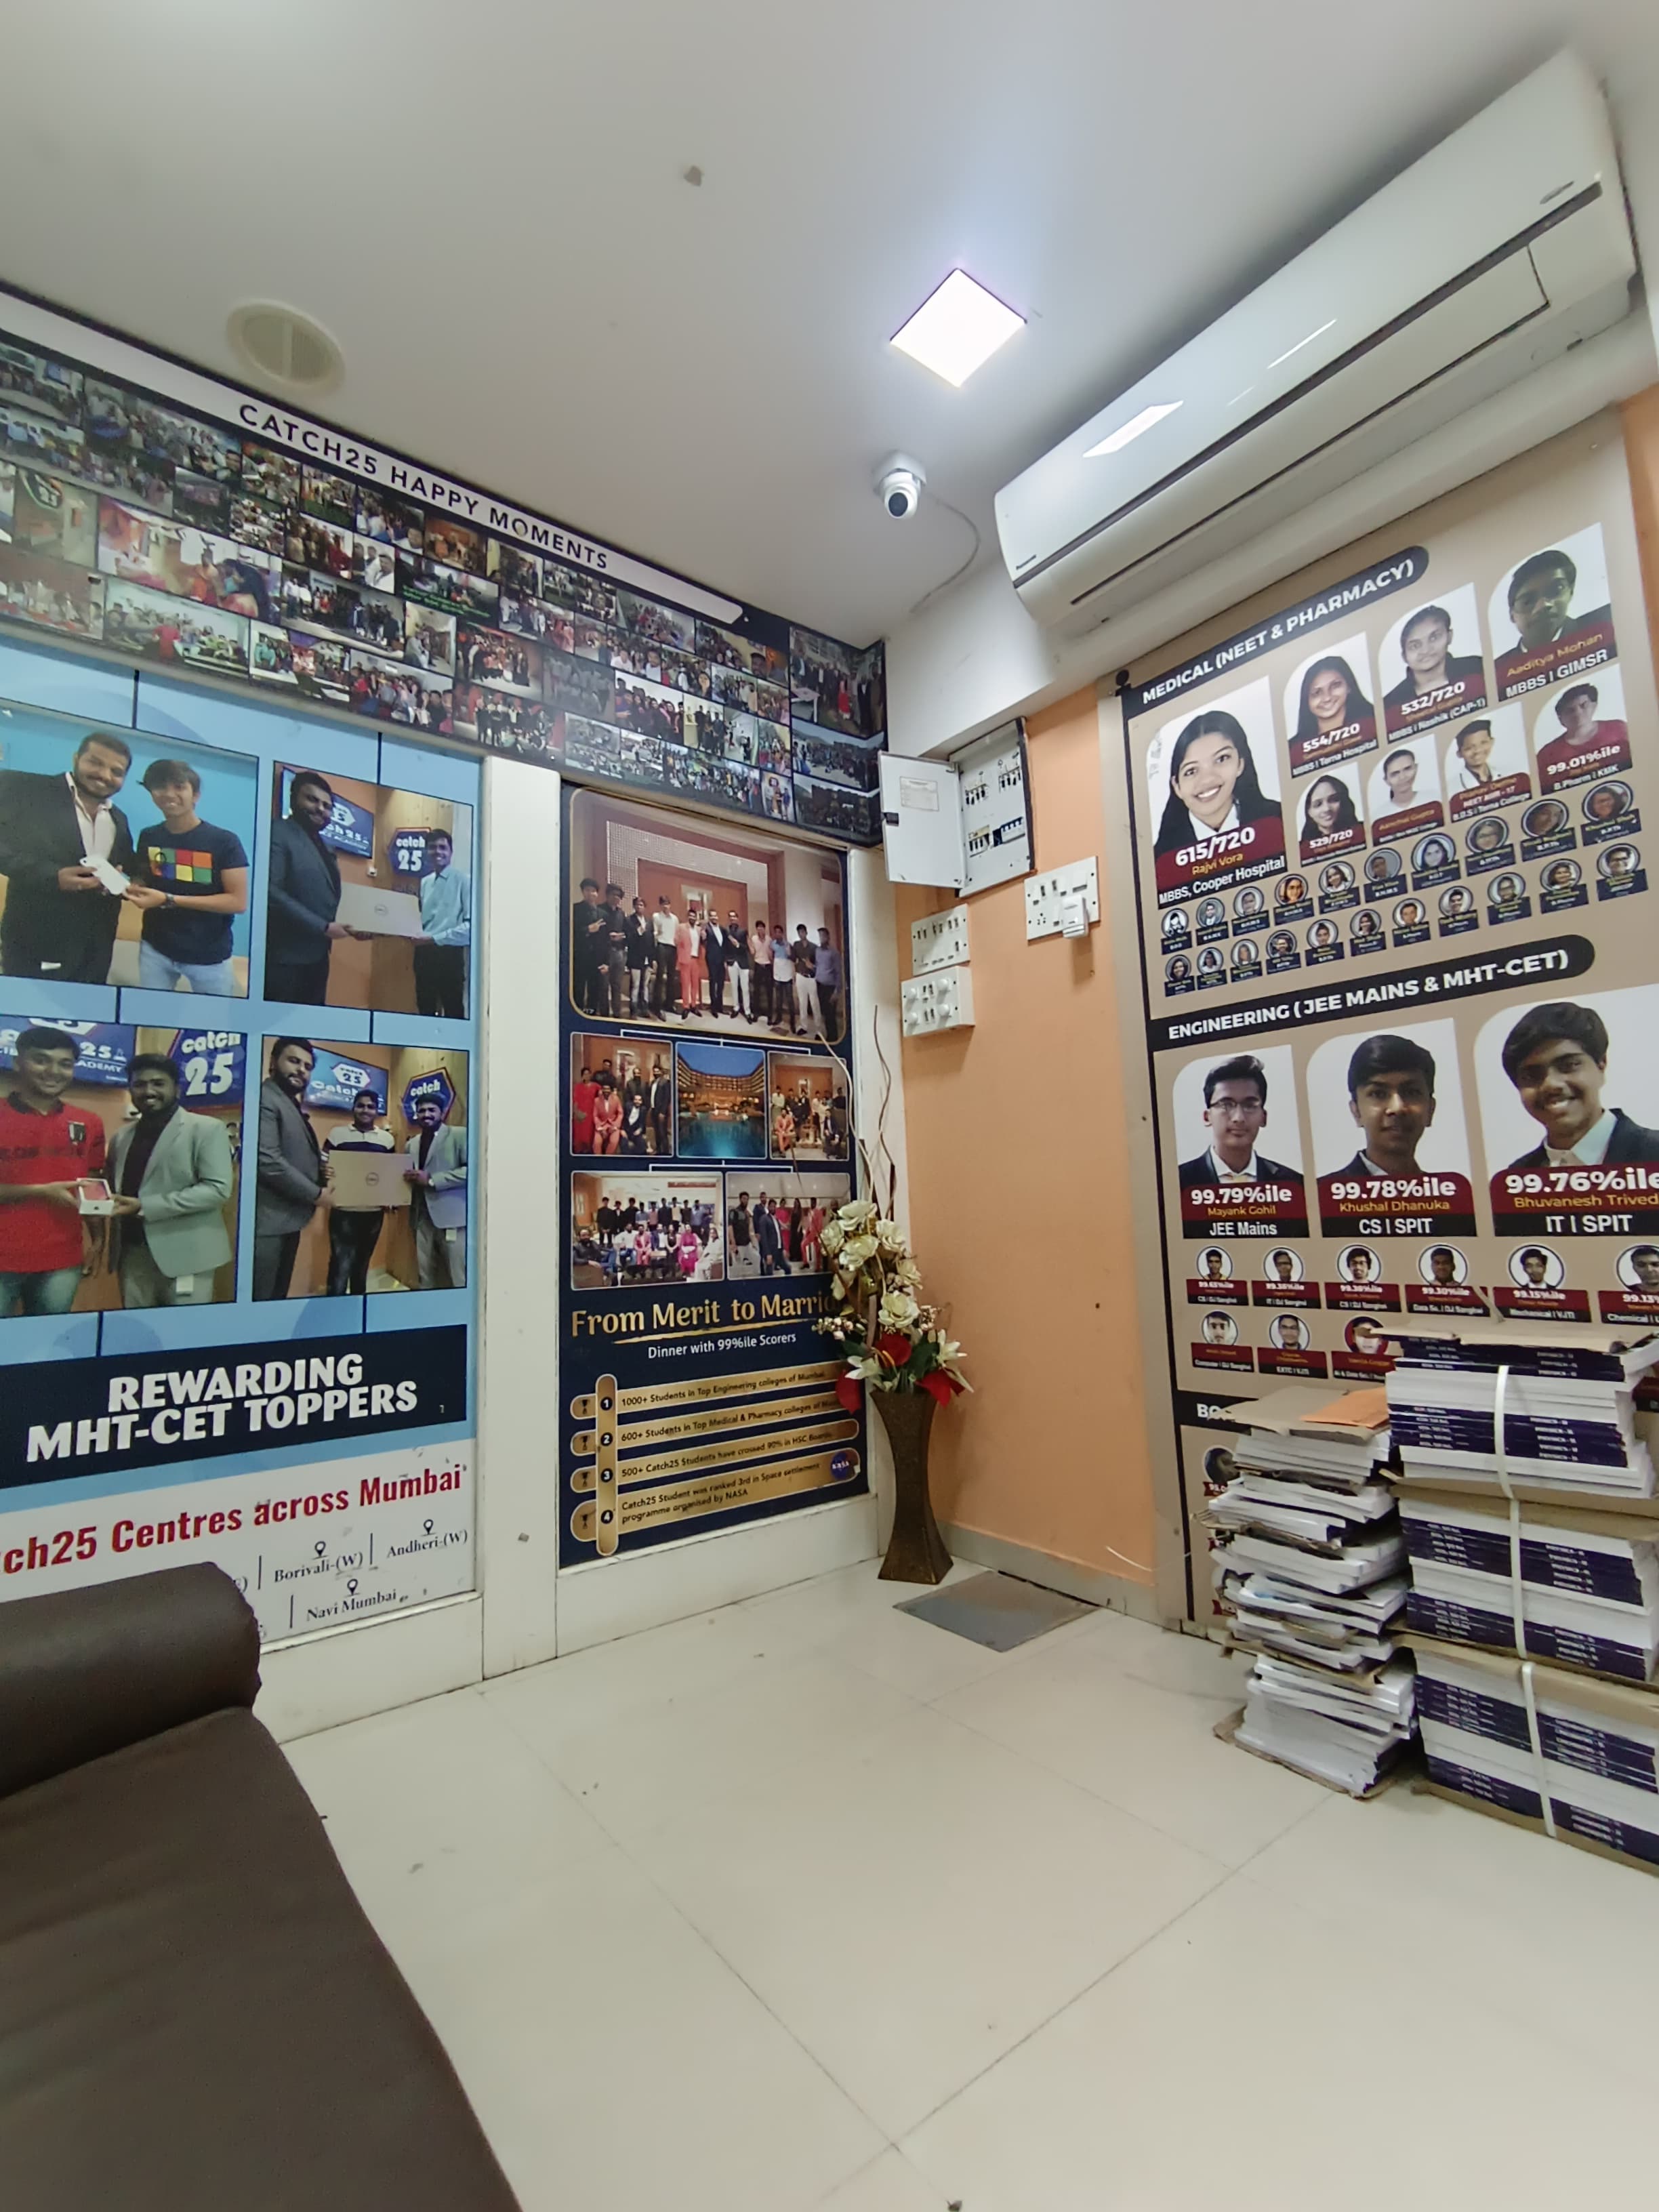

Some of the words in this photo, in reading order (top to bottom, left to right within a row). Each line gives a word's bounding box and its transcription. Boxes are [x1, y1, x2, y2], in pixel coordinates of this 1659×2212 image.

[240, 405, 377, 474] CATCH25
[391, 466, 478, 514] HAPPY
[489, 507, 607, 569] MOMENTS
[1143, 661, 1213, 704] MEDICAL
[1216, 632, 1267, 669] (NEET
[1271, 624, 1284, 640] &
[1287, 558, 1414, 632] PHARMACY)
[1507, 653, 1554, 677] Aaditya
[1557, 634, 1603, 657] Mohan
[1506, 674, 1546, 698] MBBS
[1557, 649, 1608, 678] GIMSR
[1401, 682, 1465, 715] 532/720
[1303, 723, 1360, 752] 554/720
[1547, 745, 1620, 775] 99.01%ile
[1175, 827, 1256, 867] 615/720
[1309, 830, 1353, 848] 529/720
[398, 849, 422, 872] 25
[1192, 859, 1217, 876] Rajvi
[1218, 853, 1244, 866] Vora
[1159, 886, 1192, 904] MBBS,
[1193, 872, 1233, 893] Cooper
[1235, 855, 1285, 882] Hospital
[1168, 1004, 1290, 1040] ENGINEERING
[1346, 980, 1420, 1008] MAINS
[1424, 977, 1440, 993] &
[1443, 949, 1568, 989] MHT-CET)
[184, 1052, 234, 1097] 25
[410, 1079, 441, 1097] catch
[1191, 1185, 1292, 1205] 99.79%ile
[1330, 1176, 1456, 1200] 99.78%ile
[1513, 1195, 1602, 1208] Bhuvanesh
[1207, 1206, 1246, 1218] Mayank
[1339, 1201, 1389, 1212] Khushal
[1391, 1200, 1450, 1211] Dhanuka
[1210, 1223, 1235, 1236] JEE
[1237, 1222, 1277, 1235] Mains
[1359, 1218, 1382, 1234] CS
[1395, 1218, 1433, 1234] SPIT
[1545, 1216, 1565, 1233] IT
[1582, 1214, 1633, 1233] SPIT
[571, 1310, 644, 1336] From
[653, 1299, 720, 1329] Merit
[731, 1299, 755, 1322] to
[648, 1345, 687, 1359] Dinner
[691, 1340, 715, 1355] with
[759, 1332, 797, 1347] Scorers
[108, 1353, 363, 1412] REWARDING
[621, 1397, 647, 1407] 1000+
[650, 1391, 686, 1403] Students
[688, 1389, 695, 1397] in
[697, 1387, 712, 1399] Top
[759, 1377, 787, 1387] colleges
[788, 1374, 797, 1382] of
[26, 1403, 232, 1462] MHT-CET
[243, 1380, 418, 1432] TOPPERS
[621, 1431, 643, 1441] 600+
[645, 1425, 682, 1438] Students
[683, 1423, 691, 1431] in
[693, 1420, 708, 1433] Top
[708, 1414, 739, 1428] Medical
[739, 1413, 746, 1422] &
[747, 1408, 782, 1420] Pharmacy
[783, 1405, 811, 1414] colleges
[621, 1467, 643, 1477] 500+
[646, 1458, 680, 1473] Catch25
[681, 1452, 716, 1467] Students
[717, 1449, 736, 1460] have
[784, 1437, 792, 1446] in
[792, 1435, 807, 1445] HSC
[622, 1496, 657, 1511] Catch25
[658, 1490, 691, 1502] Student
[709, 1479, 736, 1492] ranked
[738, 1476, 751, 1485] 3rd
[761, 1470, 782, 1481] Space
[783, 1462, 820, 1477] settlement
[0, 1526, 97, 1574] ch25
[112, 1509, 243, 1553] Centres
[253, 1490, 349, 1526] across
[360, 1464, 461, 1507] Mumbai
[603, 1511, 611, 1521] 4
[621, 1508, 671, 1524] programme
[672, 1498, 712, 1512] organised
[713, 1494, 724, 1504] by
[725, 1488, 749, 1500] NASA
[386, 1529, 468, 1559] Andheri-(W)
[274, 1551, 363, 1583] Borivali-(W)
[306, 1602, 338, 1622] Navi
[341, 1589, 397, 1613] Mumbai
